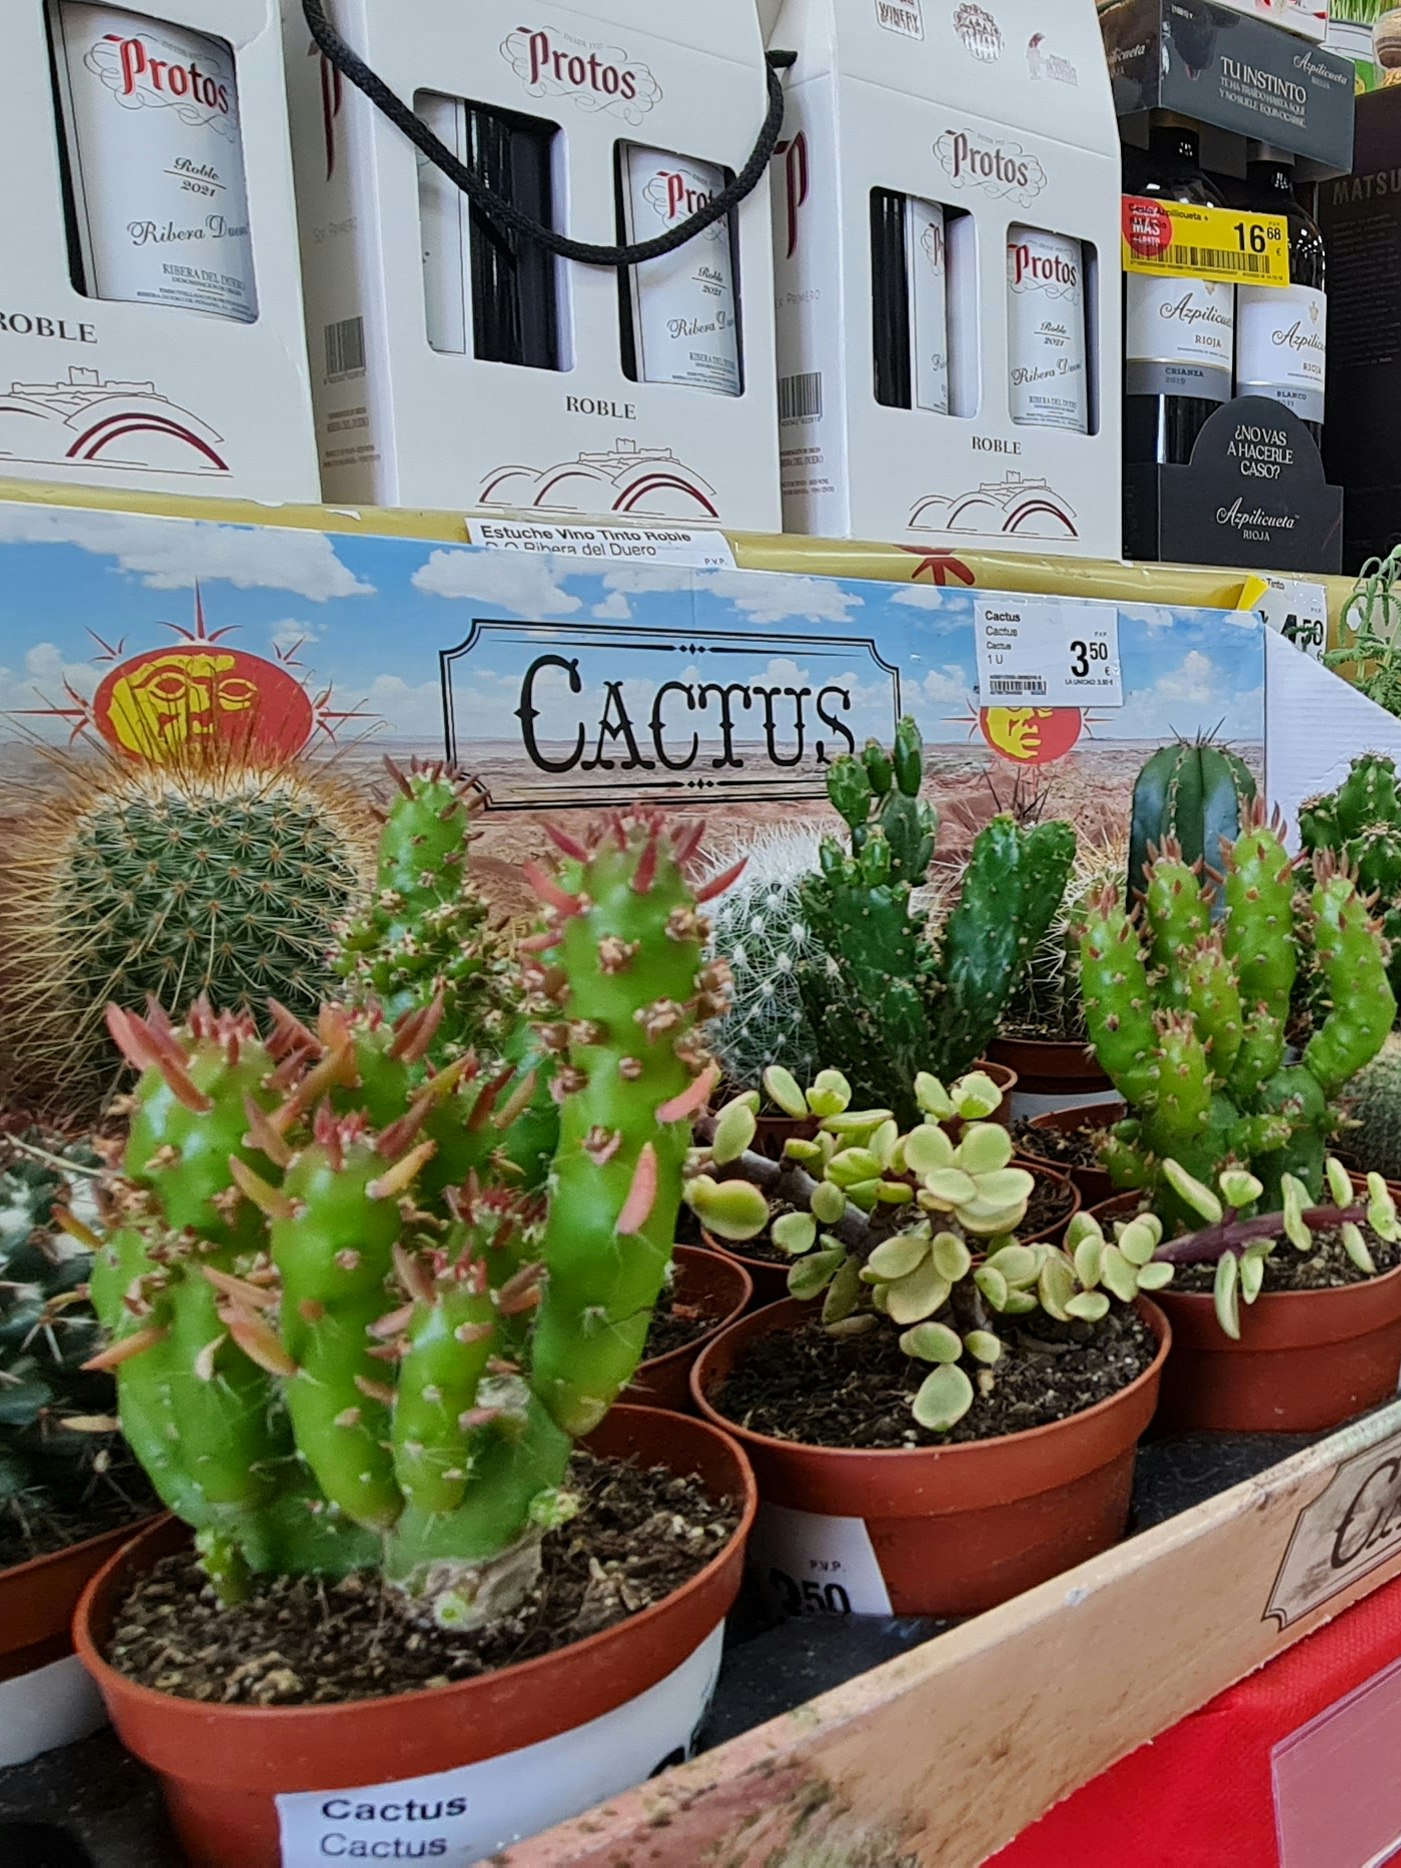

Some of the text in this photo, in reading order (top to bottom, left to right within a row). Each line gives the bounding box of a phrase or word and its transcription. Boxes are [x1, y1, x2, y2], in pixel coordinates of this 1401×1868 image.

[102, 34, 229, 115] Protos
[515, 26, 637, 101] Protos
[1293, 51, 1348, 85] Azpilicueta
[1220, 56, 1307, 104] TU INSTINTO
[173, 157, 219, 180] Roble
[944, 129, 1029, 188] Protos
[127, 220, 205, 246] Ribera
[1008, 243, 1077, 287] Protos
[667, 317, 715, 339] Ribera
[1195, 334, 1222, 348] RIOJA
[1010, 366, 1056, 386] Ribera
[1165, 366, 1204, 378] CRIANZA
[1302, 362, 1323, 375] RIOJA
[1276, 390, 1307, 401] BLANCO
[565, 395, 637, 420] ROBLE
[972, 436, 1022, 456] ROBLE
[1234, 425, 1287, 446] ¿NO VAS
[1227, 441, 1293, 464] A HACERLE
[1240, 461, 1281, 480] CASO?
[1216, 496, 1296, 529] Azpilicueta
[480, 525, 553, 541] Estuche
[555, 528, 595, 541] Vino
[596, 530, 641, 542] Tinto
[1243, 529, 1270, 542] RIOJA
[582, 542, 606, 556] del
[611, 543, 656, 557] Duero
[985, 610, 1021, 622] Cactus
[985, 626, 1018, 637] Cactus
[986, 641, 1012, 650] Cactus
[514, 654, 856, 773] CACTUS
[322, 1797, 468, 1821] Cactus
[320, 1831, 448, 1859] Cactus
